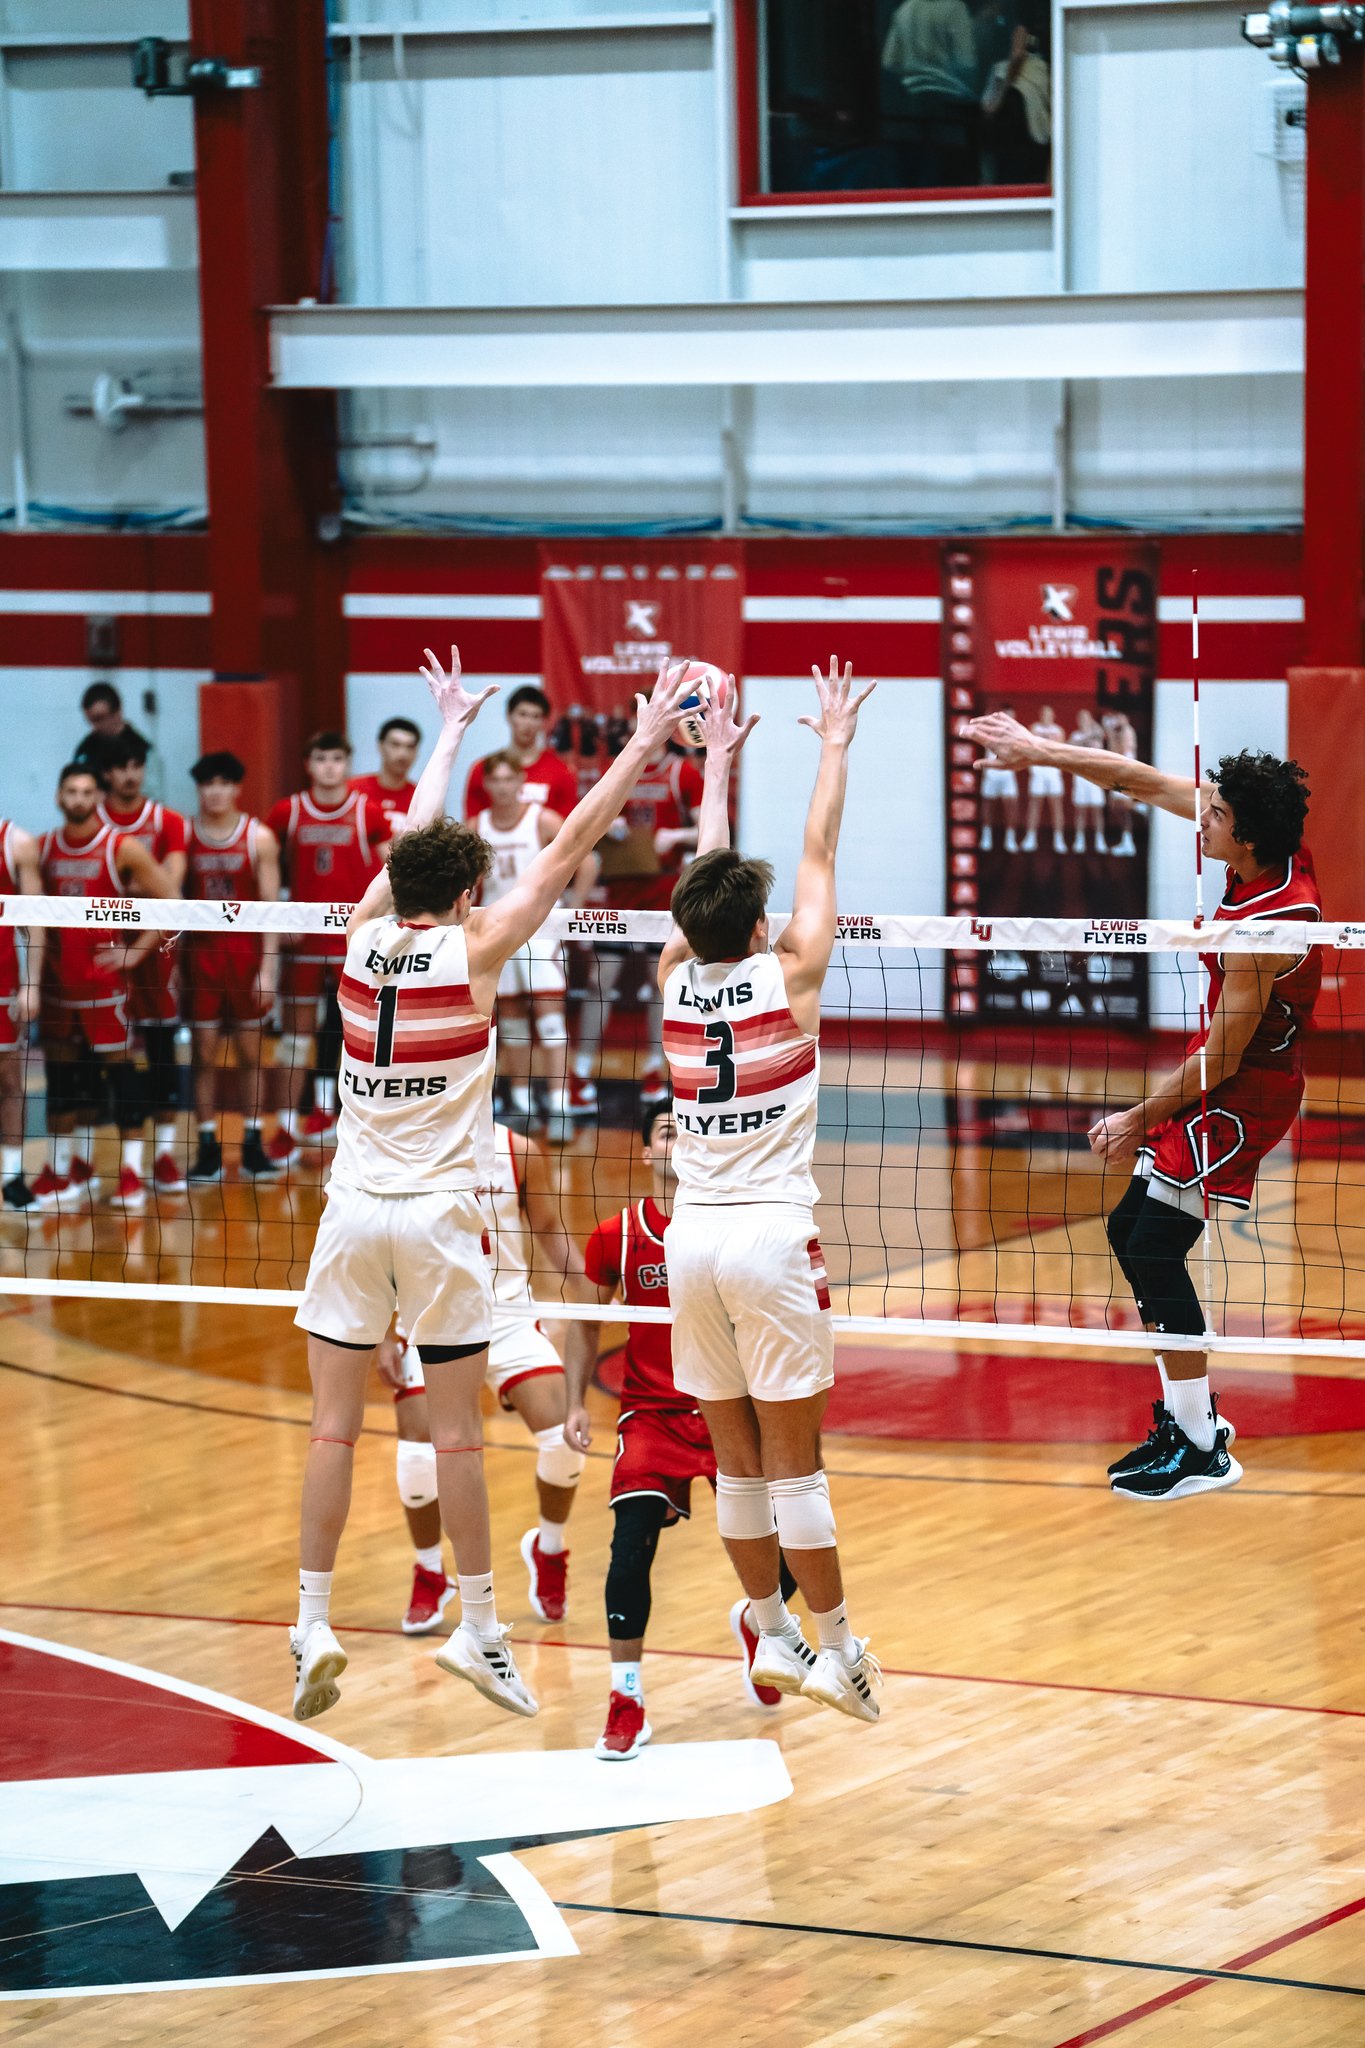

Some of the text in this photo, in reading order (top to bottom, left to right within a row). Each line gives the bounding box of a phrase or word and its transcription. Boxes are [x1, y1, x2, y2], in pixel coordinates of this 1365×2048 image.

[1029, 625, 1088, 640] LEWIS
[994, 639, 1122, 659] VOLLEYBALL
[91, 899, 133, 909] LEWIS
[330, 904, 356, 915] LEW
[85, 910, 141, 922] FLYERS
[324, 915, 349, 927] FLY
[575, 910, 619, 921] LEWIS
[837, 916, 873, 926] EWIS
[568, 922, 627, 934] FLYERS
[970, 919, 992, 942] LU
[1091, 920, 1139, 931] LEWIS
[835, 927, 881, 940] YERS
[1084, 932, 1147, 945] FLYERS
[365, 949, 432, 975] LEWIS
[375, 985, 398, 1068] 1
[697, 1020, 736, 1105] 3
[344, 1069, 447, 1098] FLYERS
